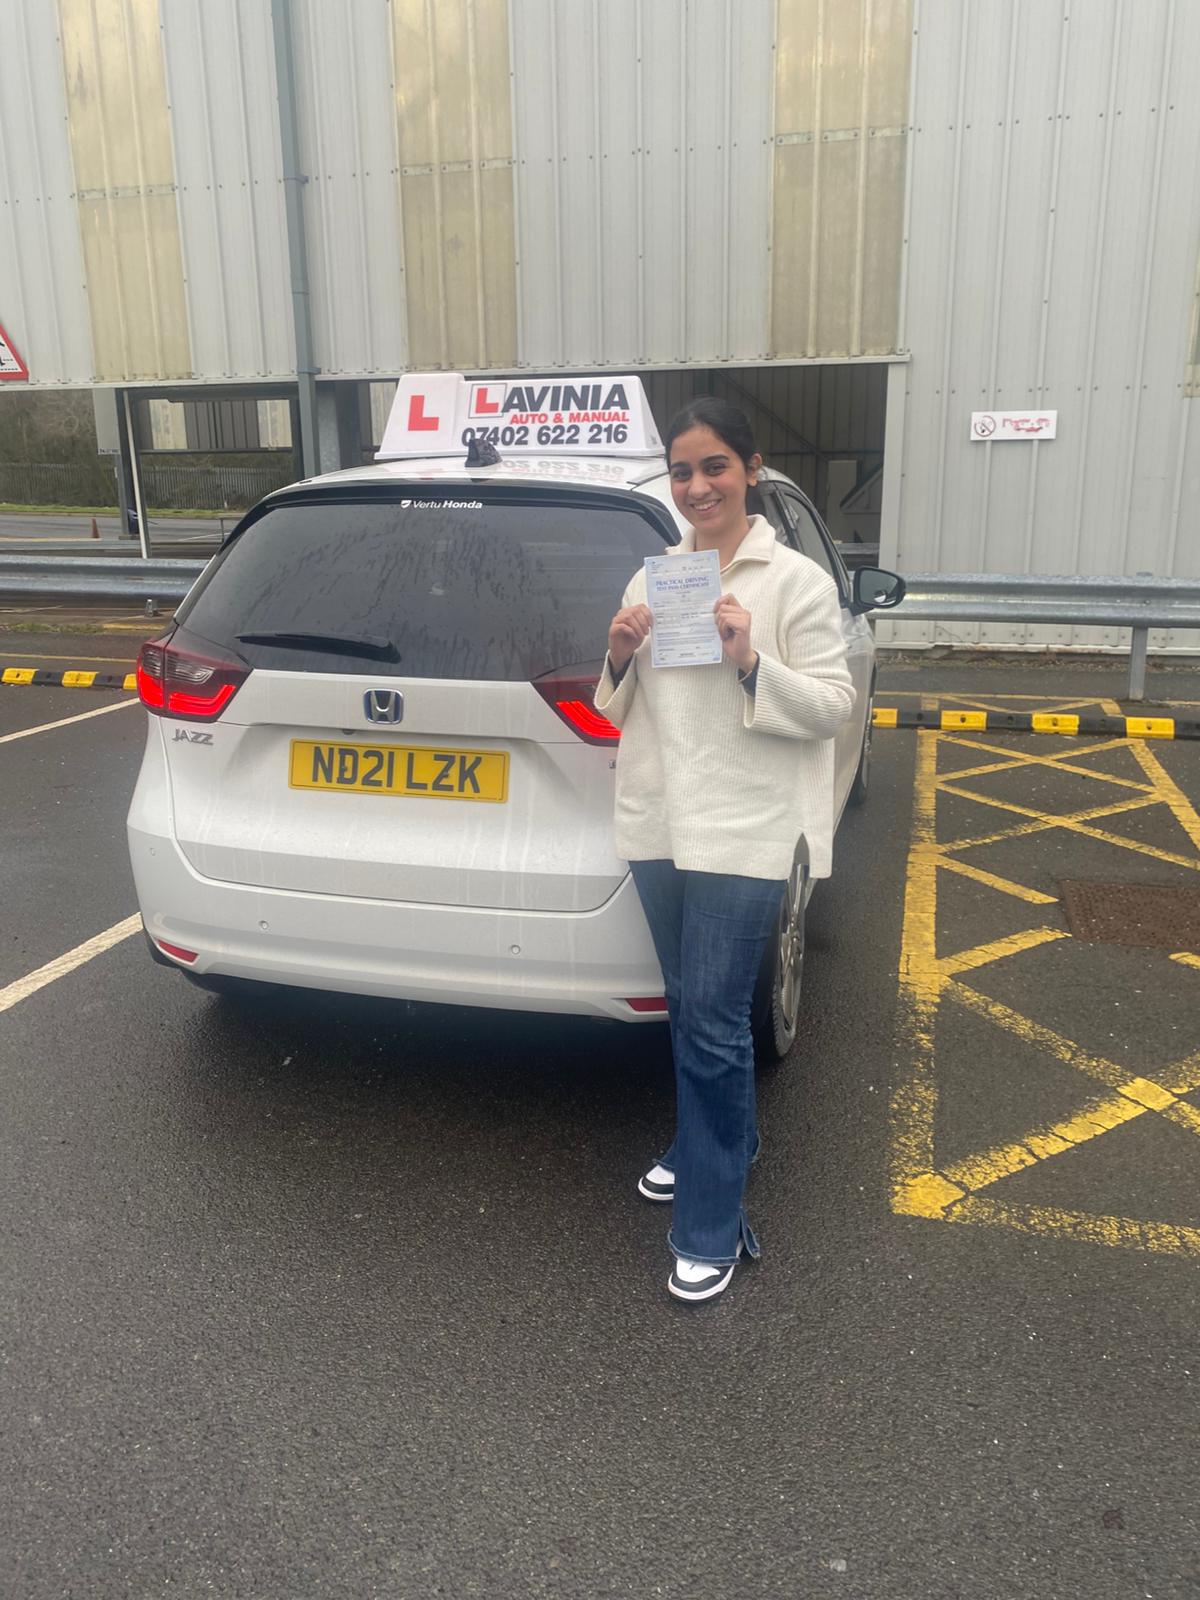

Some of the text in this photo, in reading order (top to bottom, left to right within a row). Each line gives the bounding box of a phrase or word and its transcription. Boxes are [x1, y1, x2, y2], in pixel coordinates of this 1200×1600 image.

[475, 384, 630, 414] LAVINIA
[408, 395, 439, 431] L
[510, 411, 630, 425] AUTO & MANUAL
[461, 423, 628, 447] 07402 622 216
[413, 500, 483, 509] Vertu Honda
[656, 576, 709, 587] PRACTICAL DRIVING
[171, 728, 214, 746] JAZZ
[312, 746, 482, 794] ND21 LZK
